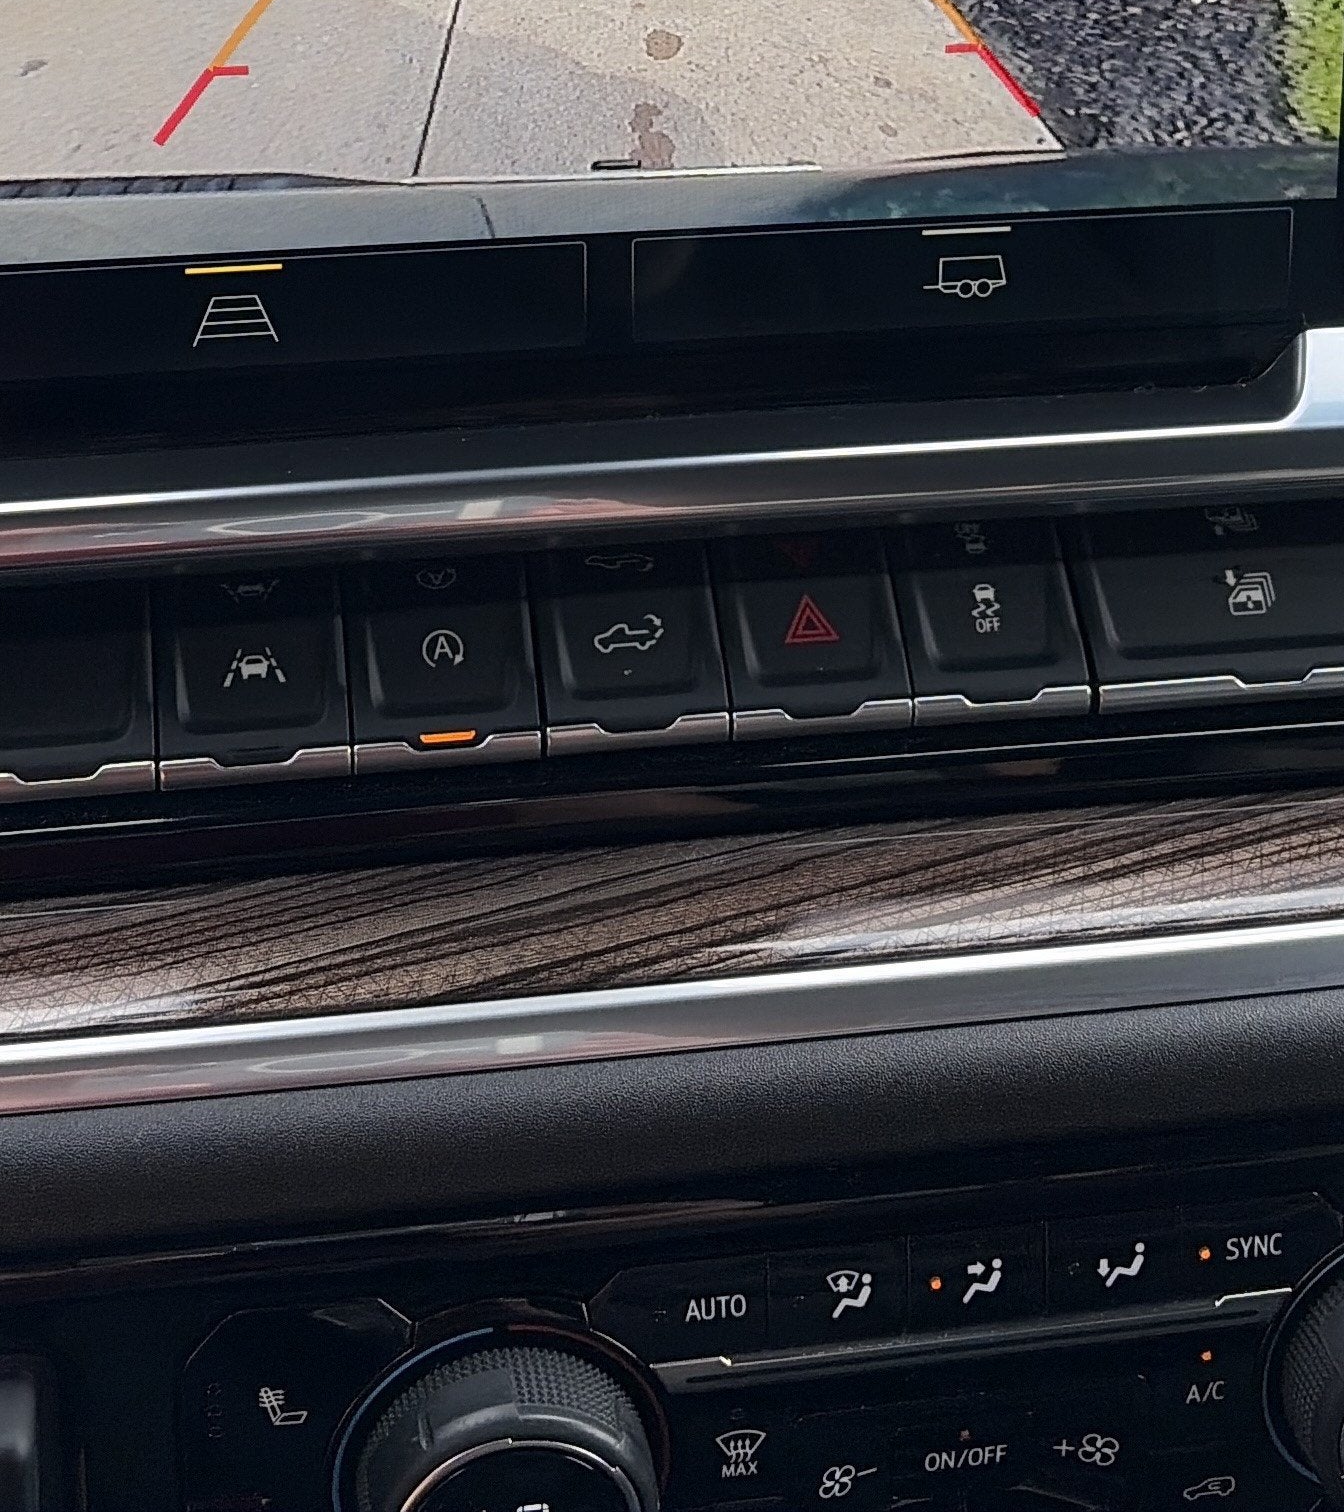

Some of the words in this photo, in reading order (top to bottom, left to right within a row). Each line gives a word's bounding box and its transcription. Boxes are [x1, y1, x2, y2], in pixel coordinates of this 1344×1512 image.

[975, 617, 1001, 634] OFF
[1225, 1232, 1284, 1262] SYNC
[684, 1293, 748, 1324] AUTO
[1185, 1380, 1225, 1405] A/C
[720, 1459, 759, 1478] MAX
[923, 1443, 1008, 1472] ON/OFF
